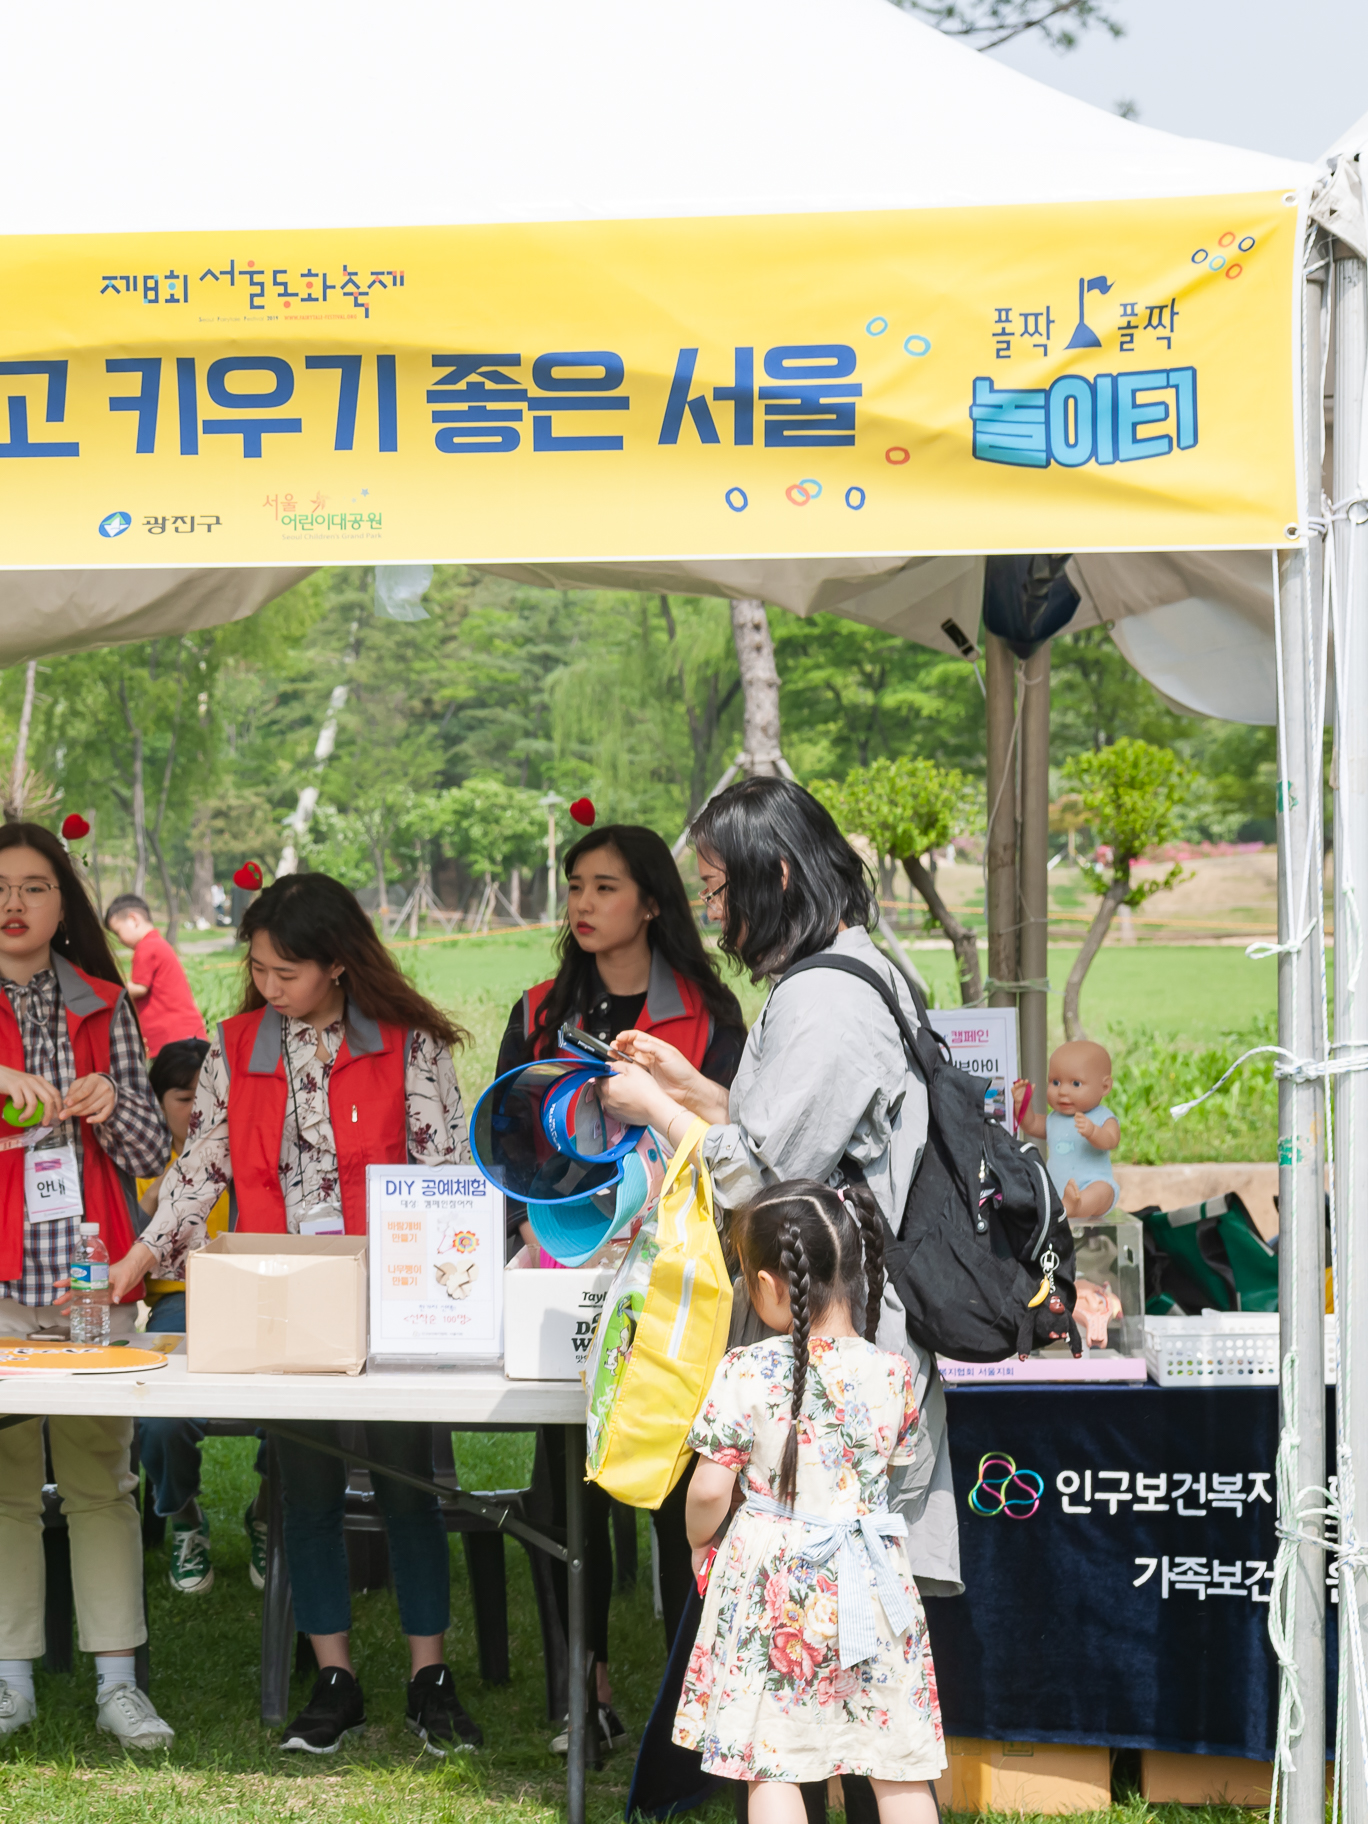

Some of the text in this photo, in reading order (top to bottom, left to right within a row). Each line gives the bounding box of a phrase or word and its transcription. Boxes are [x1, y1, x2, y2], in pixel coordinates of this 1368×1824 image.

[100, 269, 189, 304] 제8회
[991, 297, 1180, 359] 폴짝 폴짝
[105, 354, 398, 459] 키우기
[426, 350, 630, 455] 좋은
[657, 343, 863, 448] 서울
[969, 366, 1199, 470] 놀이터
[262, 492, 299, 521] 서울
[142, 515, 224, 535] 광진구
[281, 511, 383, 531] 어린이대공원
[304, 532, 340, 541] Children's
[342, 532, 364, 540] Grand
[366, 532, 382, 540] Park
[951, 1029, 989, 1044] 캠페인
[952, 1058, 999, 1073] 브아이
[36, 1177, 66, 1198] 안내
[385, 1178, 486, 1197] DIY 공예체험
[387, 1221, 422, 1232] 바람개비
[392, 1233, 418, 1244] 만들기
[392, 1276, 418, 1287] 만들기
[978, 1367, 1015, 1377] 서울지회
